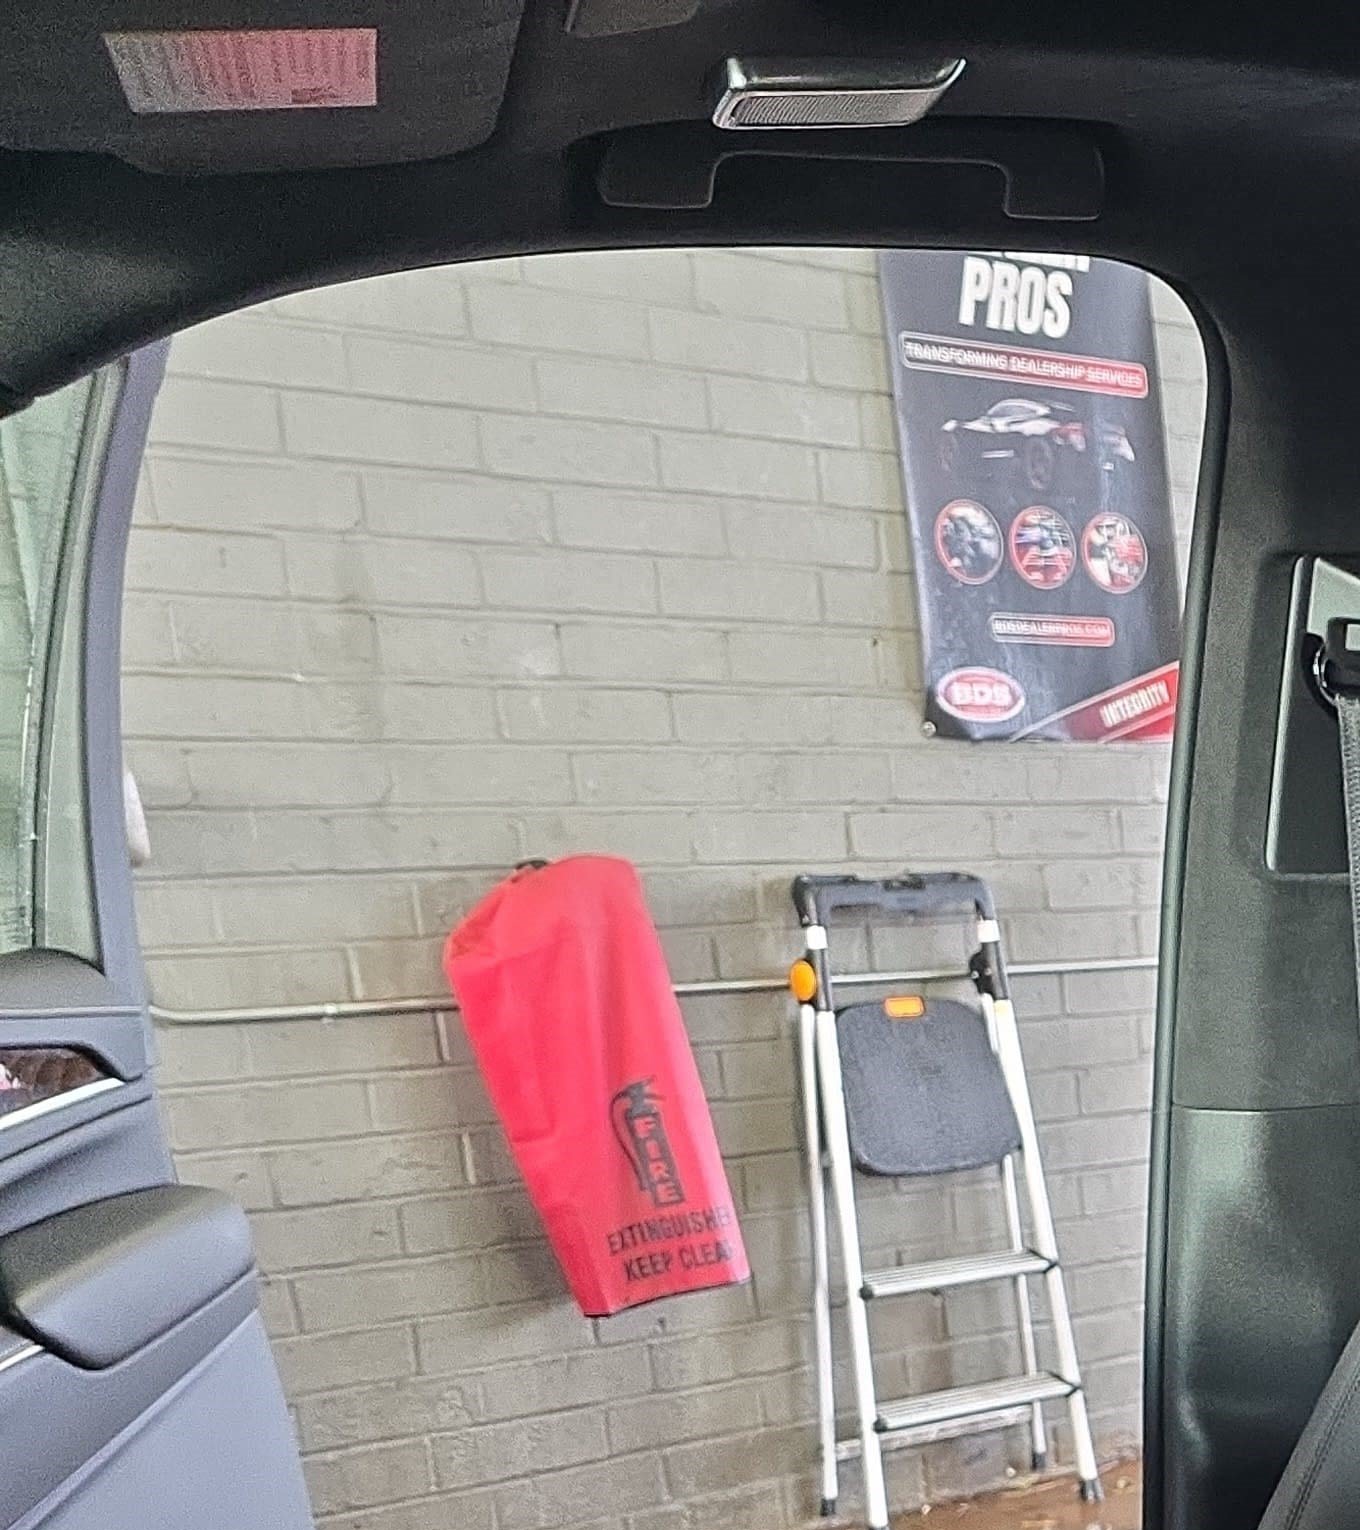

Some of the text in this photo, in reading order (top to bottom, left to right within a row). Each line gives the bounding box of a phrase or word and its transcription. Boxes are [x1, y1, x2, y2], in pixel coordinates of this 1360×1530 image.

[958, 257, 1073, 339] PROS
[903, 342, 1143, 388] TRANSFORMING DEALERSHIP SERVICES
[1100, 680, 1170, 728] INTEGRITY
[634, 1117, 681, 1203] FIRE
[624, 1250, 672, 1281] KEEP
